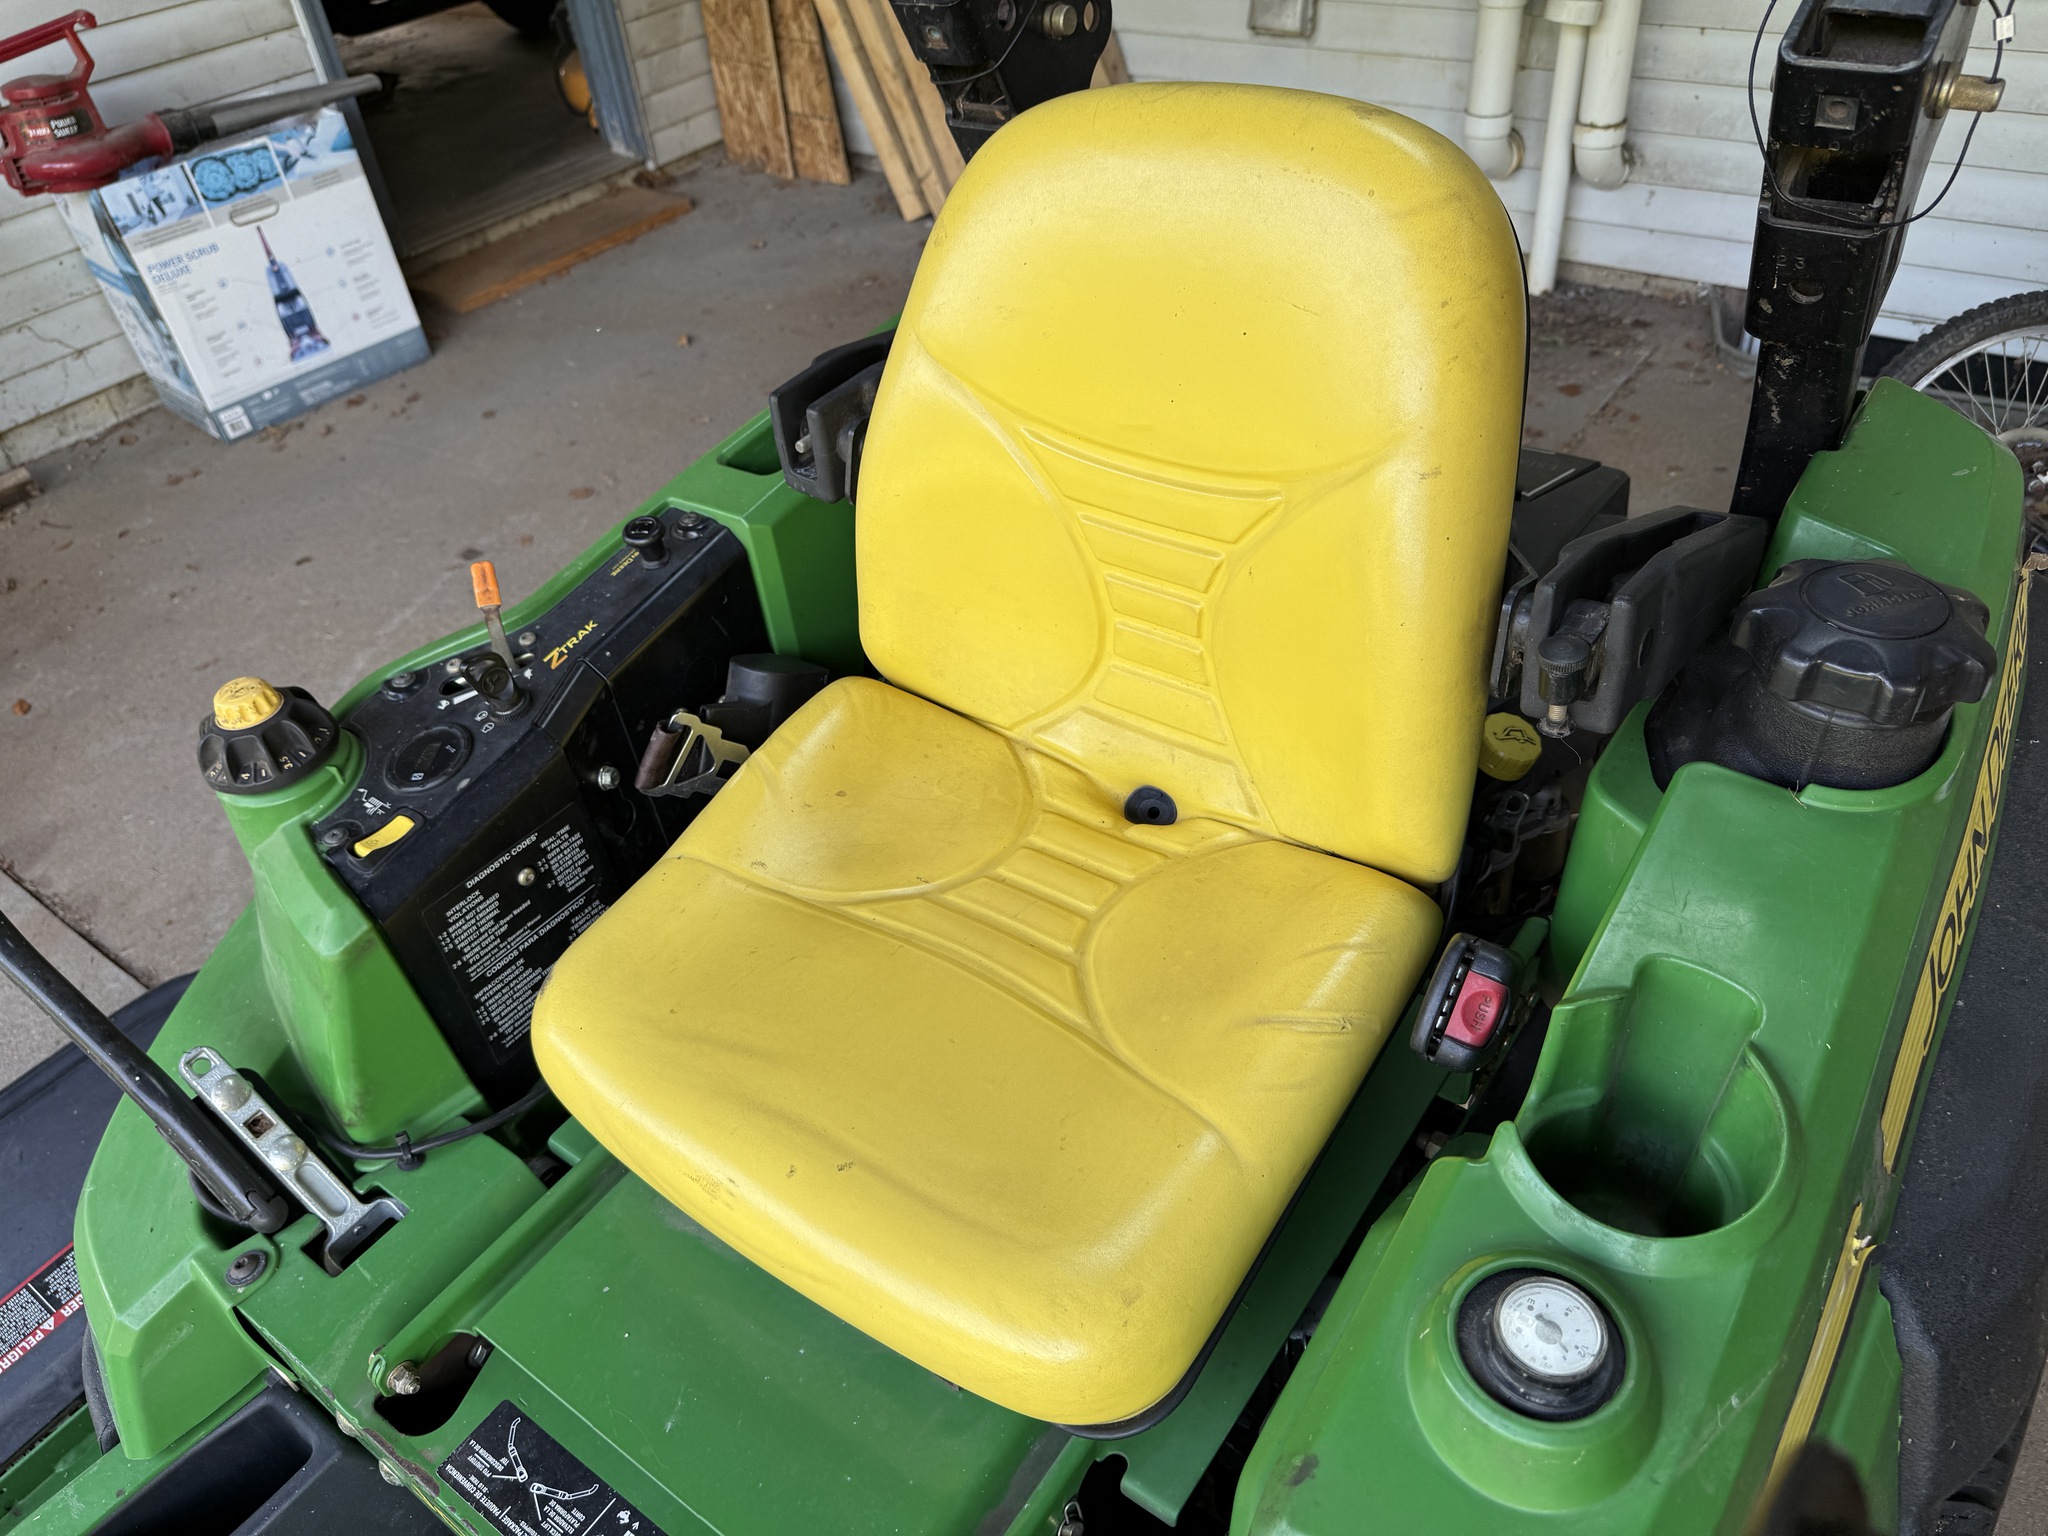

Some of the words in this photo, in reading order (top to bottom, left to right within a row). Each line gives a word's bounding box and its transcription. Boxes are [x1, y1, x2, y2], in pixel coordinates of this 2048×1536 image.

[147, 252, 184, 274] POWER
[185, 242, 220, 262] SCRUB
[152, 264, 192, 285] DELUXE
[280, 755, 294, 770] 3.5
[540, 823, 570, 849] REAL-TIME
[546, 832, 569, 852] FAULTS
[546, 846, 560, 860] OVER
[559, 831, 581, 850] VOLTAGE
[549, 852, 564, 865] WEAK
[563, 836, 584, 855] BATTERY
[553, 859, 573, 876] SYSTEM
[572, 848, 586, 862] ISSUE
[559, 846, 580, 865] STARTER
[465, 851, 511, 889] DIAGNOSTIC
[556, 864, 575, 881] OUTPUT
[574, 853, 590, 867] FAULT
[558, 866, 582, 887] DETECTED
[565, 875, 579, 888] Check
[578, 864, 594, 878] Engine
[445, 888, 480, 918] INTERLOCK
[448, 894, 484, 924] VIOLATIONS
[448, 917, 465, 933] BRAKE
[464, 909, 476, 921] NOT
[475, 891, 500, 912] ENGAGED
[475, 899, 499, 920] ENGAGED
[570, 905, 592, 924] FALLAS
[591, 898, 600, 908] DE
[454, 924, 477, 944] STARTER
[476, 907, 500, 928] THERMAL
[570, 913, 591, 931] TIEMPO
[590, 902, 605, 916] REAL
[1923, 793, 1990, 1050] JOHN
[457, 930, 480, 950] PROTECT
[479, 918, 495, 933] MODE
[462, 944, 481, 961] ENGINE
[480, 934, 495, 947] OVER
[494, 923, 509, 937] TEMP
[468, 953, 480, 964] PTO
[485, 949, 519, 977] CODIGOS
[518, 933, 539, 951] PARA
[473, 964, 517, 999] INFRACCIONES
[515, 957, 525, 967] DE
[479, 965, 525, 1002] INTERBLOQUEO
[485, 991, 502, 1007] FRENO
[501, 985, 510, 994] NO
[509, 967, 533, 988] APLICADO
[490, 1002, 506, 1017] MODO
[505, 997, 513, 1005] DE
[512, 974, 542, 999] PROTECCION
[493, 1014, 501, 1022] DE
[499, 988, 533, 1017] ARRANCADOR
[1470, 994, 1492, 1031] PUSH
[1526, 1297, 1536, 1305] E
[1564, 1304, 1580, 1314] 1/4
[0, 1330, 44, 1374] PELIGR
[1577, 1344, 1589, 1358] 1/2
[468, 1438, 476, 1447] LA
[473, 1443, 481, 1451] DE
[467, 1454, 484, 1471] SHUTOFF
[478, 1447, 504, 1472] DESCONEXION
[482, 1467, 492, 1477] PTO
[499, 1455, 510, 1465] TDF
[444, 1463, 477, 1494] CONVENIENCIA
[472, 1489, 483, 1499] DE
[479, 1494, 501, 1516] PAQUETE
[548, 1498, 556, 1507] DE
[542, 1504, 550, 1513] LA
[547, 1509, 556, 1517] DE
[553, 1502, 580, 1528] PLATAFORMA
[570, 1506, 586, 1521] CORTE
[500, 1514, 524, 1535] PACKAGE
[540, 1519, 551, 1531] LIFT
[553, 1513, 575, 1534] ELEVADOR
